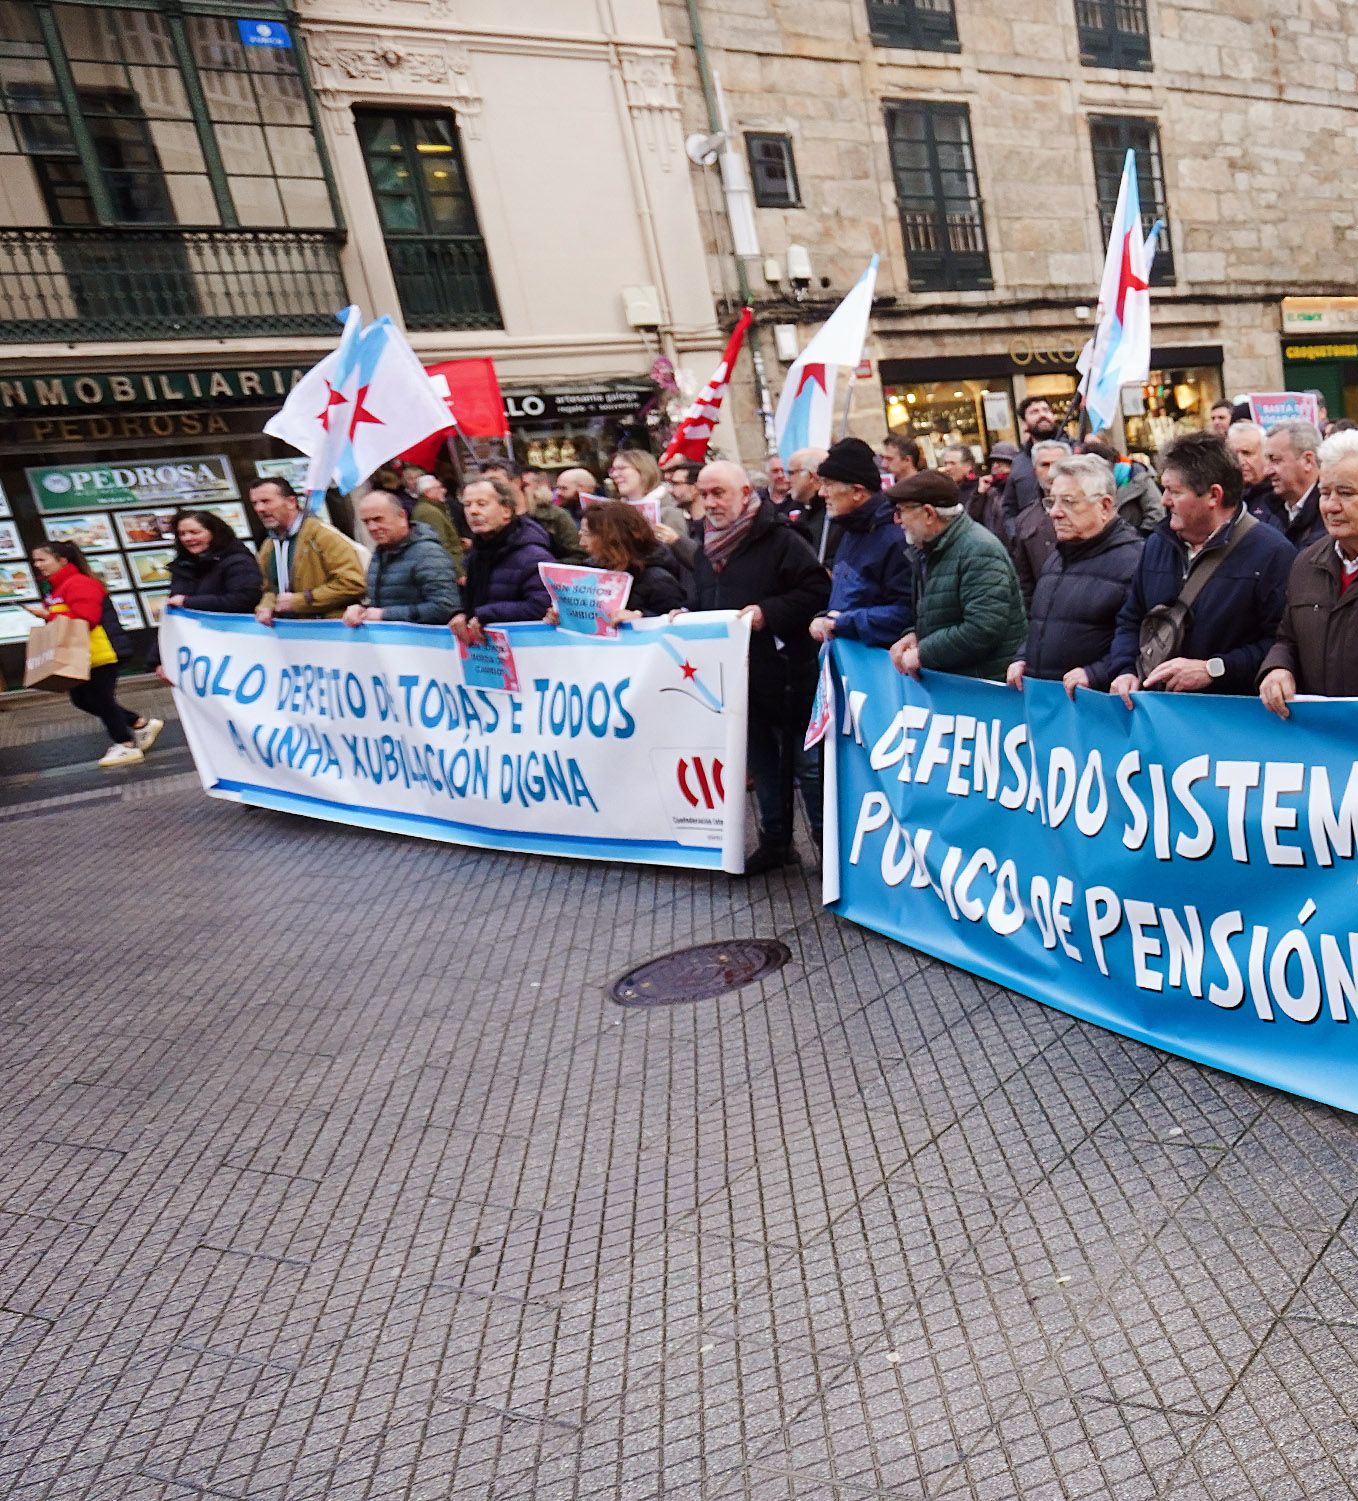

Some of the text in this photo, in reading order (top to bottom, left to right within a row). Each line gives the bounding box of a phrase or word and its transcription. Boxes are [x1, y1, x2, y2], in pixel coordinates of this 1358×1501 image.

[33, 412, 230, 442] PEDROSA
[503, 396, 545, 418] LO
[70, 463, 218, 491] PEDROSA
[178, 646, 266, 704] POLO
[278, 665, 367, 720] DEREITO
[398, 675, 499, 735] TODAS
[511, 694, 523, 734] E
[534, 677, 636, 740] TODOS
[253, 722, 342, 779] UNHA
[501, 750, 599, 813] DIGNA
[1047, 746, 1109, 837] DO
[1030, 875, 1083, 963] DE
